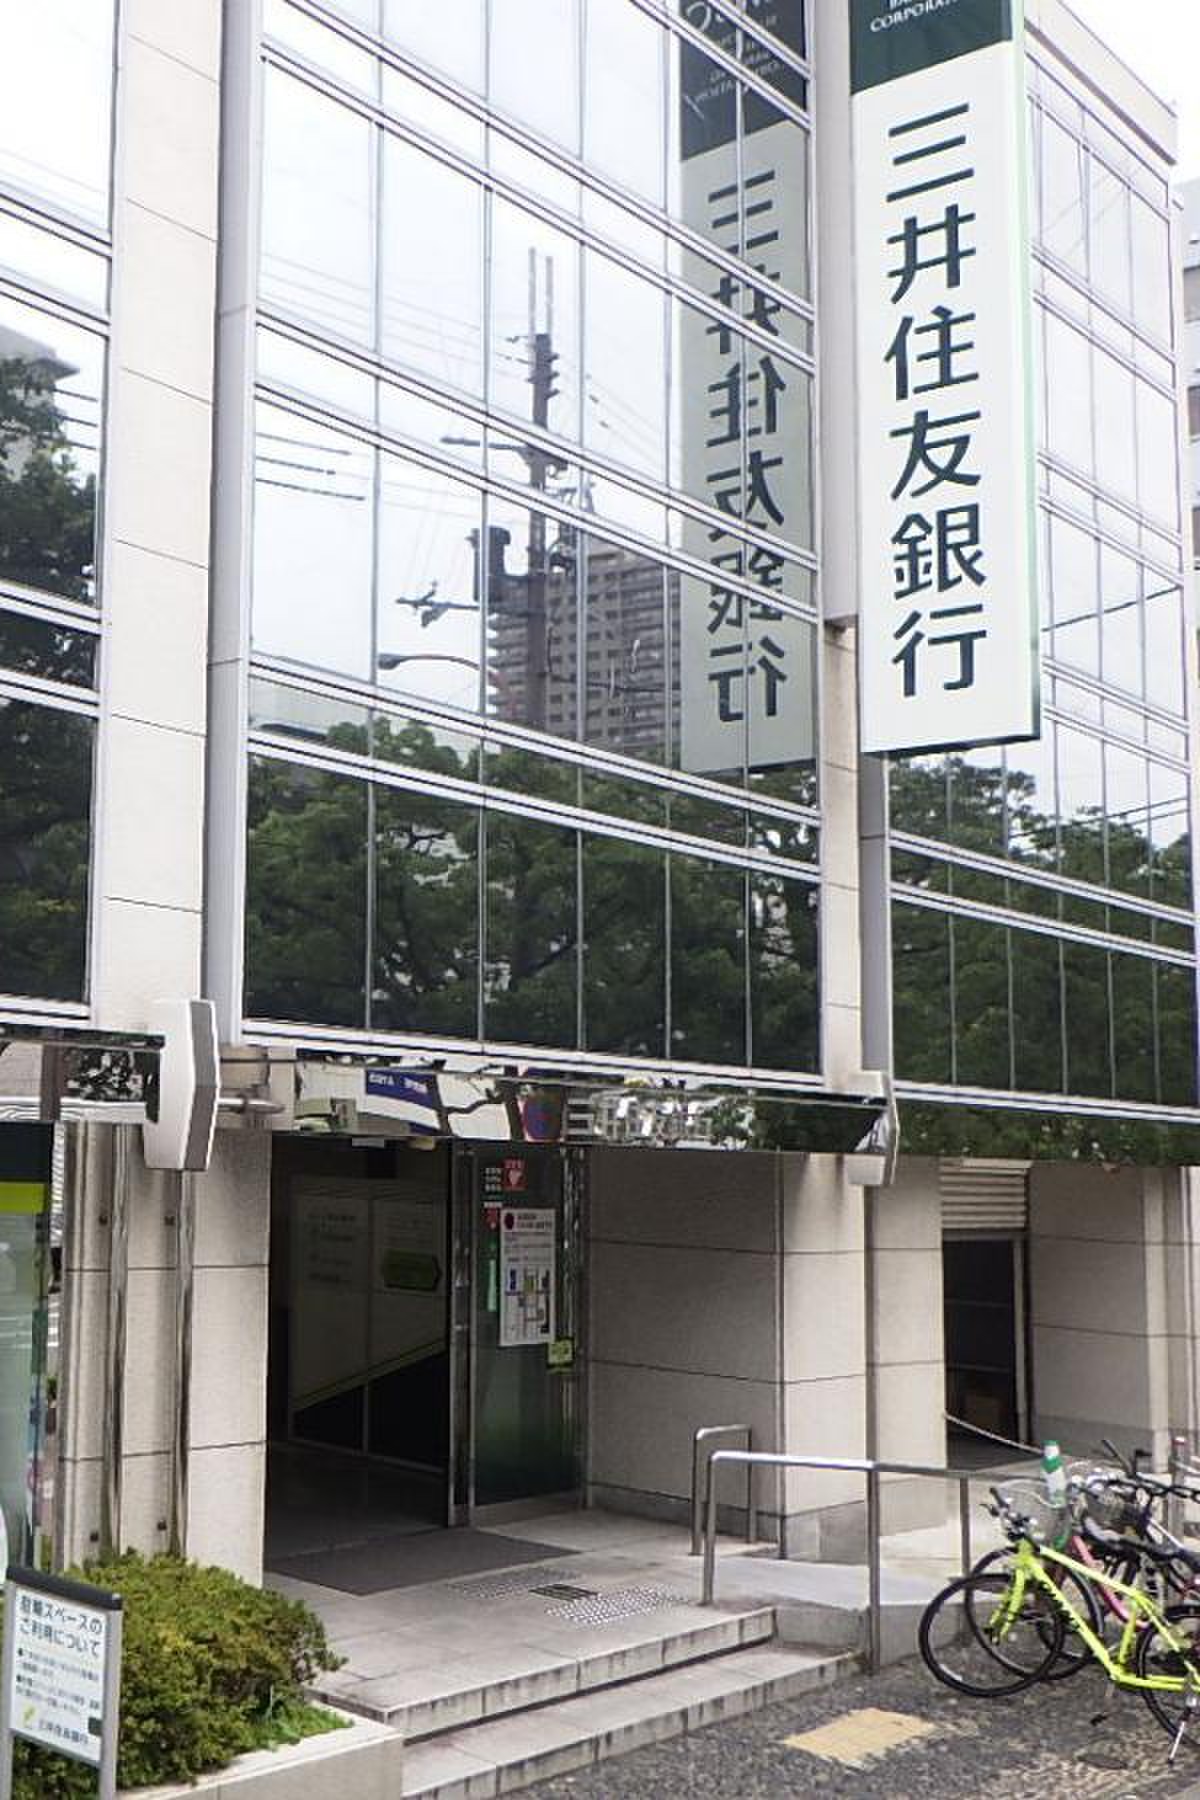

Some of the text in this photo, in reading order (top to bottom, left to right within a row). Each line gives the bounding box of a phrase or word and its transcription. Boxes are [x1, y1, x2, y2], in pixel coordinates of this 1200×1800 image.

[884, 103, 987, 698] 三井住友銀行
[19, 1618, 101, 1659] ご利用について
